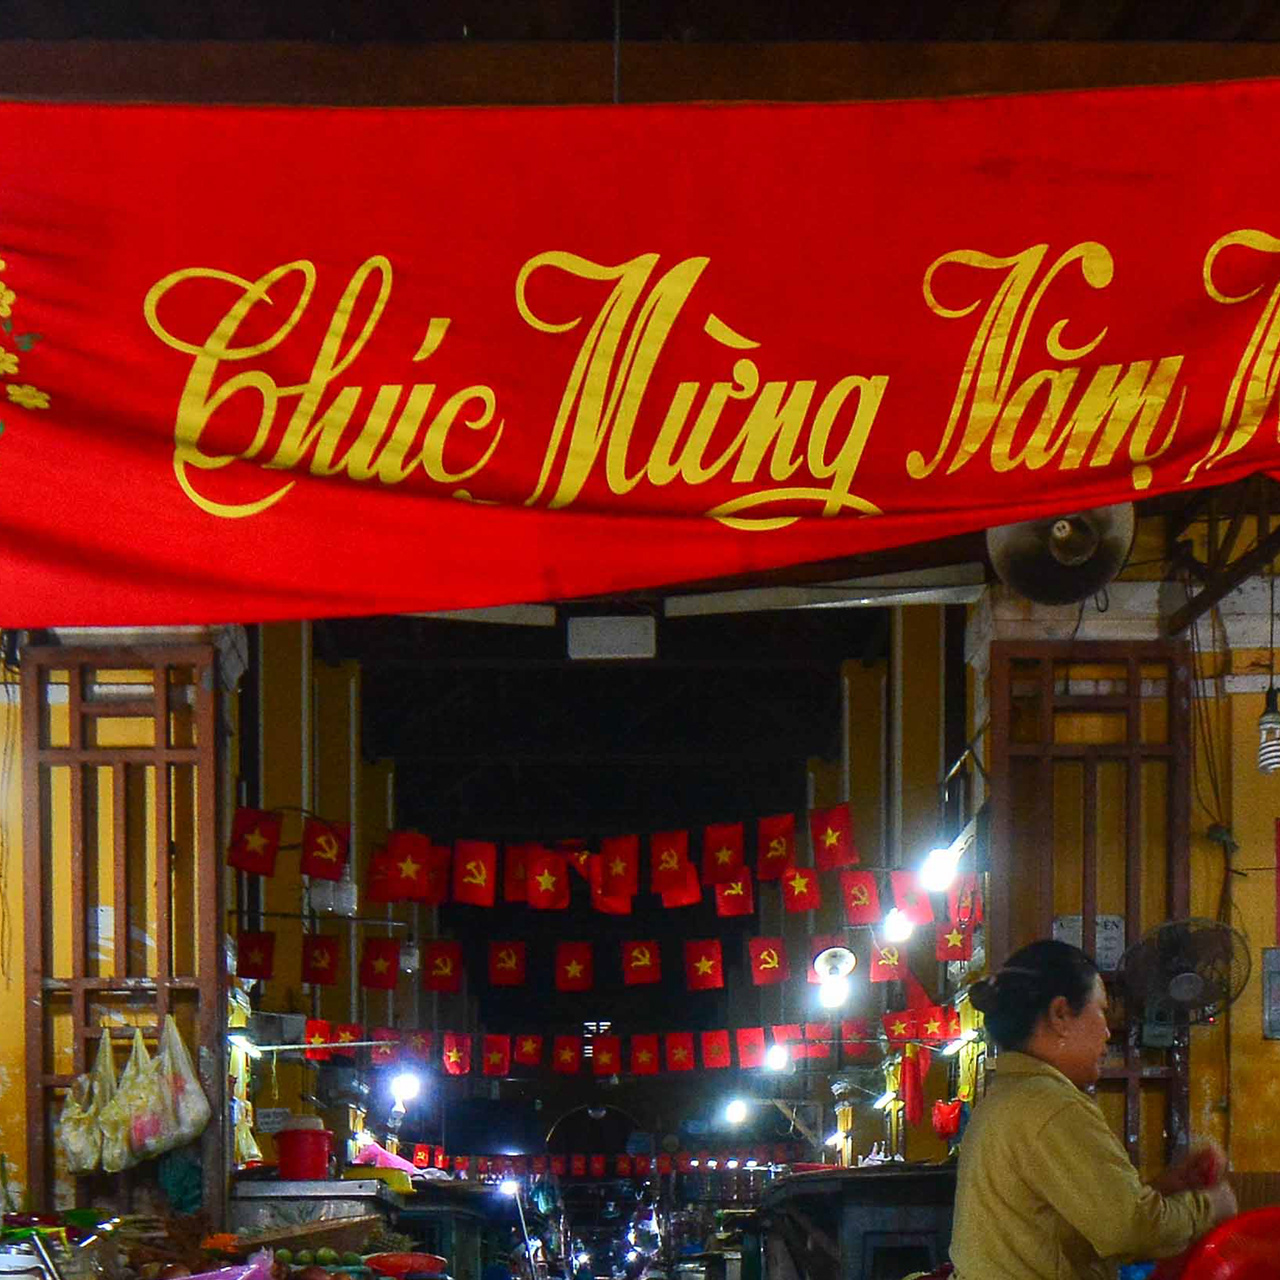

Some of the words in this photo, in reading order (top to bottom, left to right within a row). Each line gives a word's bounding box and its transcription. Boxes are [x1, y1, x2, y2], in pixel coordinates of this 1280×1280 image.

[143, 255, 505, 518] Chúc
[516, 250, 890, 531] Mừng
[906, 241, 1187, 490] Năm
